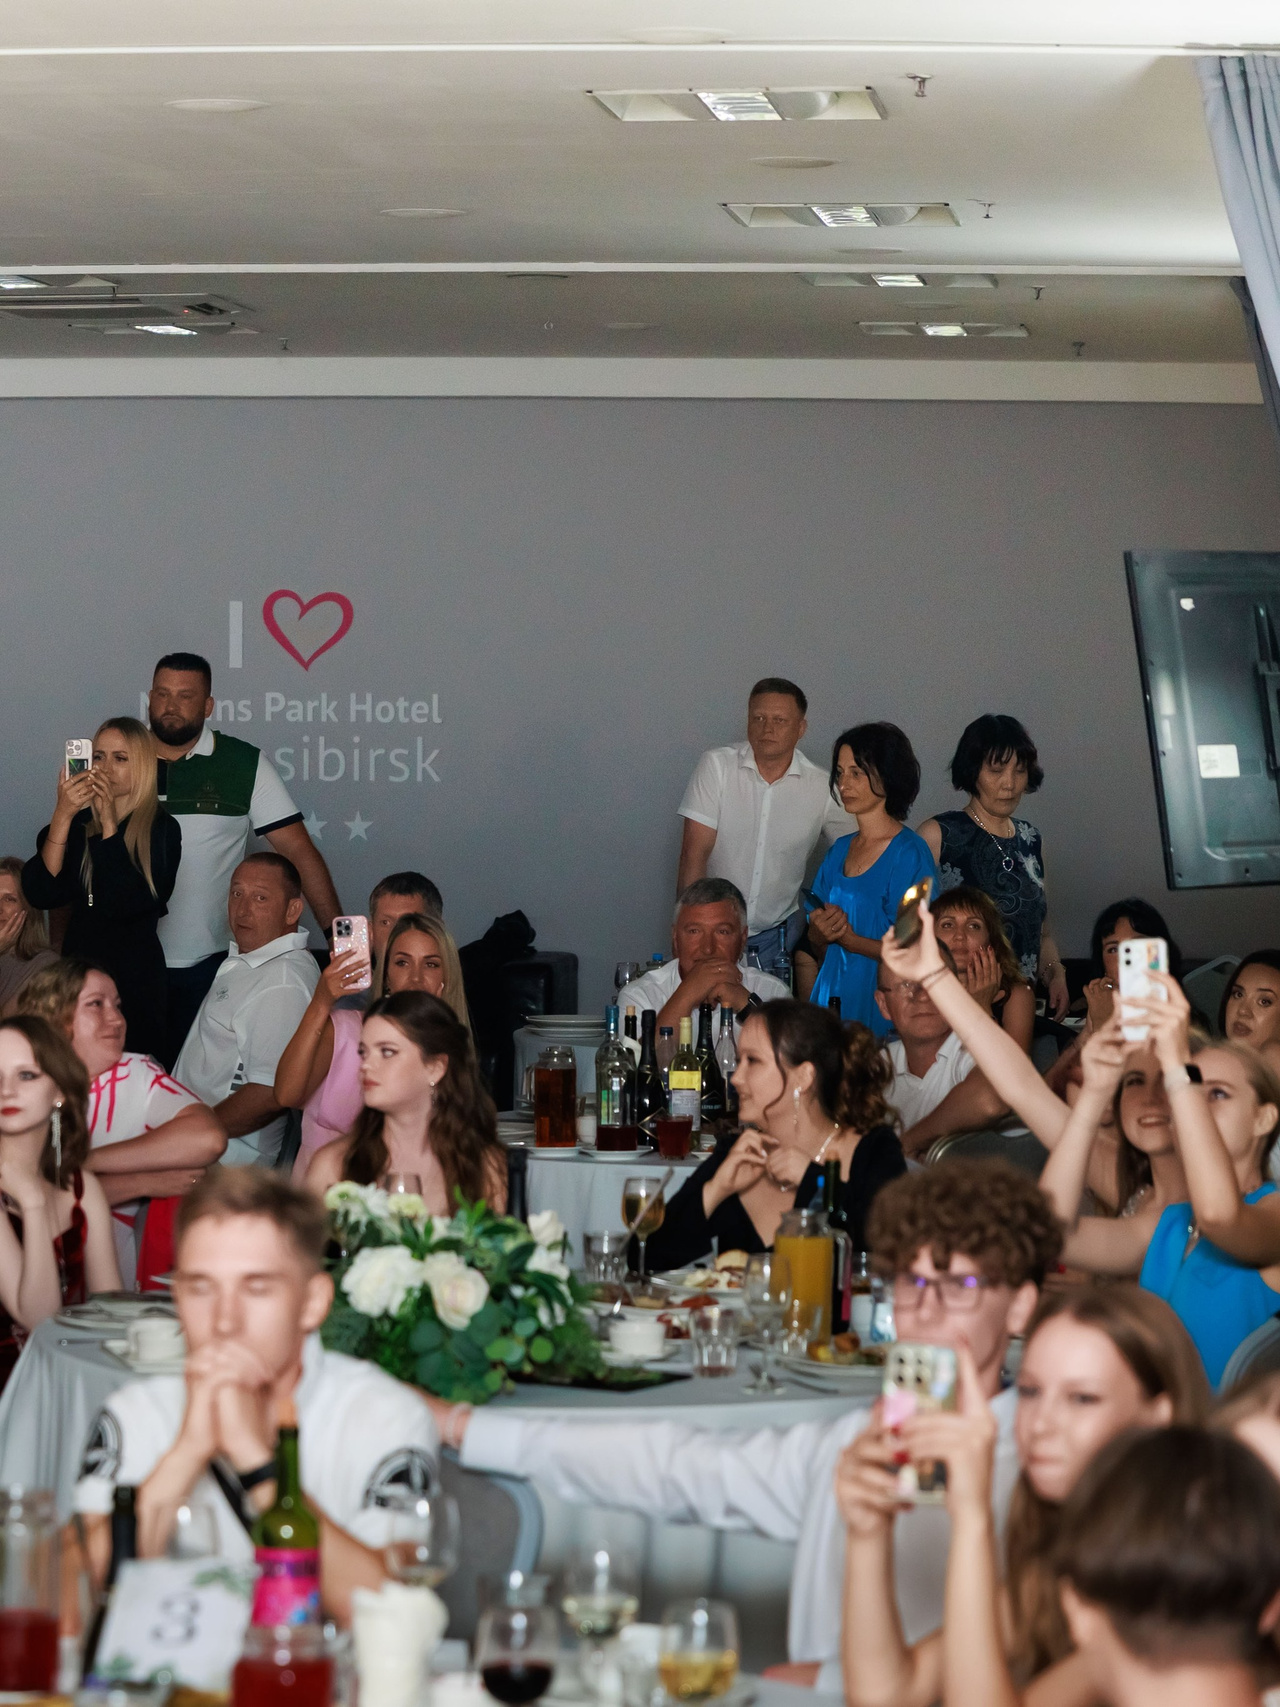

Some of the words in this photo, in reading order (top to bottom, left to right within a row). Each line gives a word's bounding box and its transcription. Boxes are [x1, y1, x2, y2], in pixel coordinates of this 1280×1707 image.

[229, 601, 243, 669] I
[265, 691, 338, 722] Park
[350, 692, 443, 723] Hotel
[274, 736, 442, 783] sibirsk
[151, 1592, 201, 1646] 3
